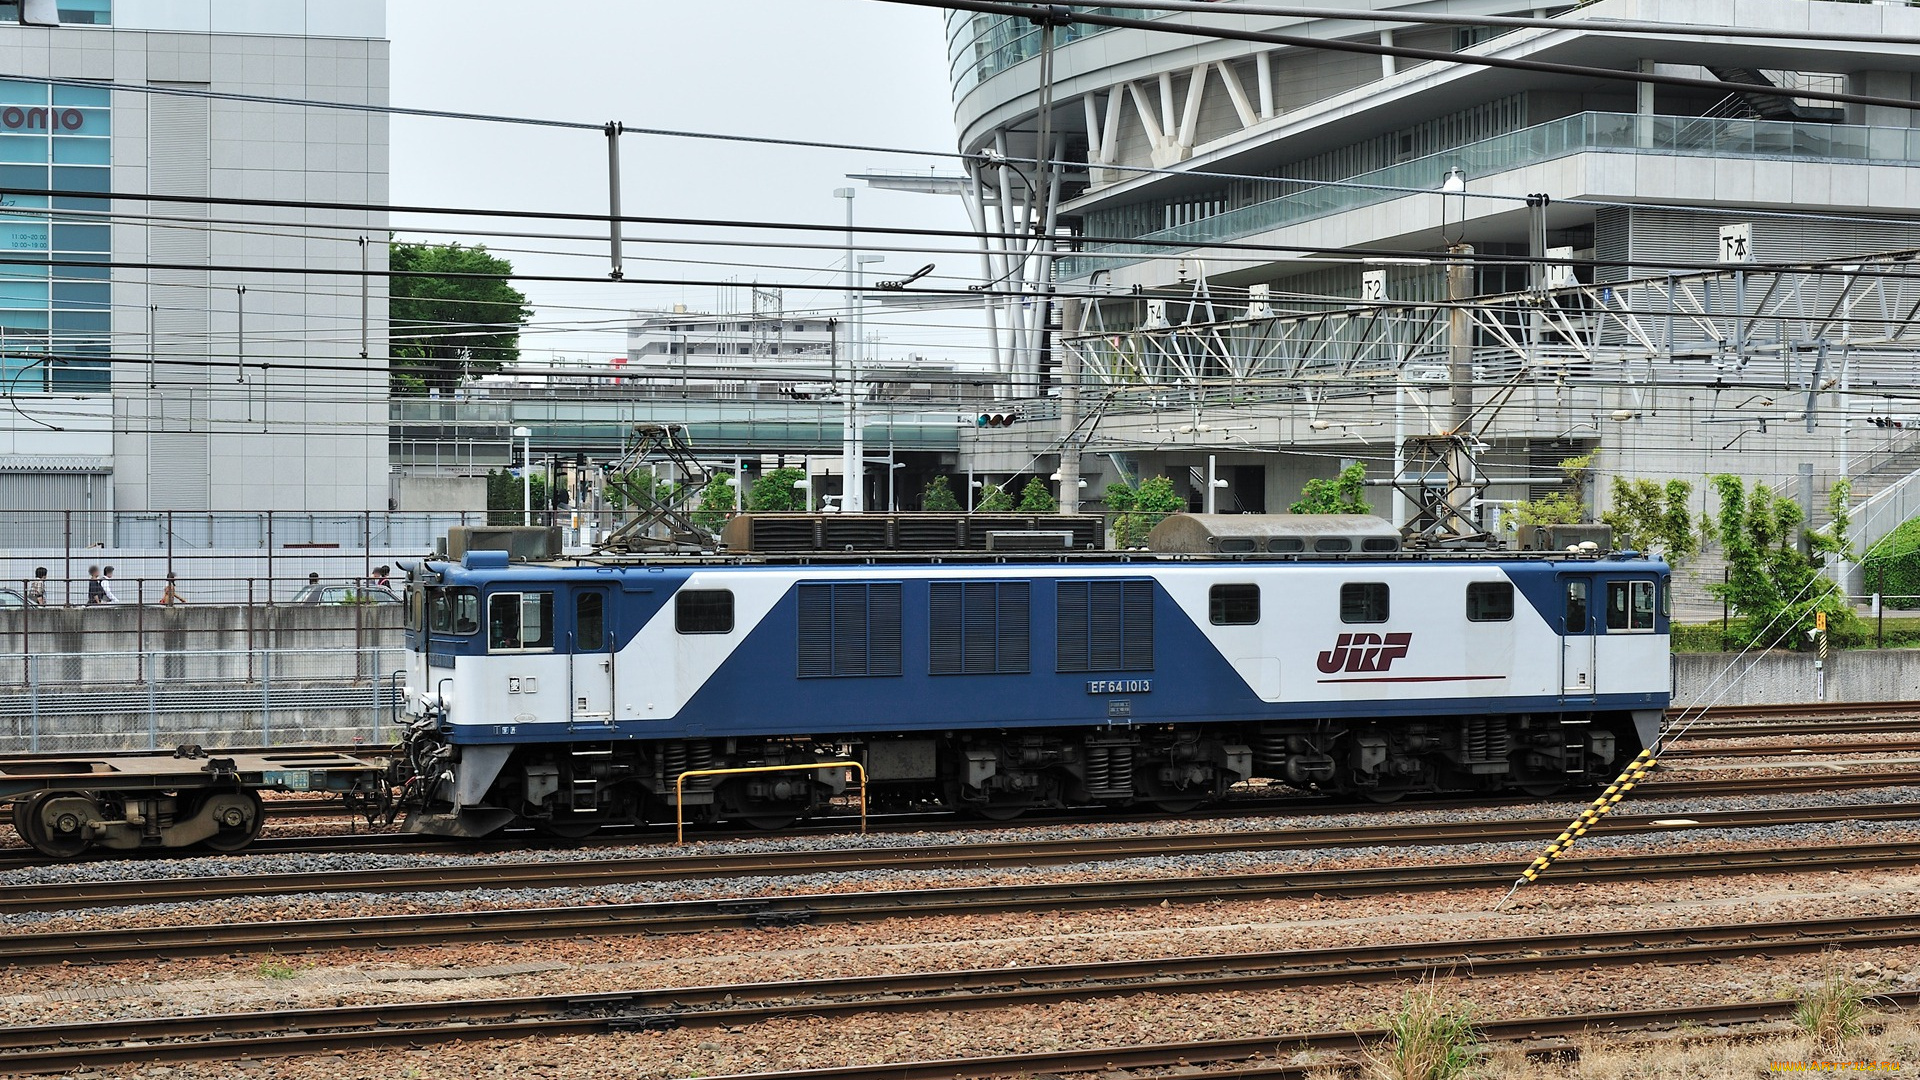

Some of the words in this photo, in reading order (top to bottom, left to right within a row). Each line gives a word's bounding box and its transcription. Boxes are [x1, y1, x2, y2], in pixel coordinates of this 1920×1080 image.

[0, 106, 84, 130] omo
[1722, 234, 1747, 261] 下本
[1316, 632, 1413, 674] JRF
[1126, 680, 1150, 692] 1013
